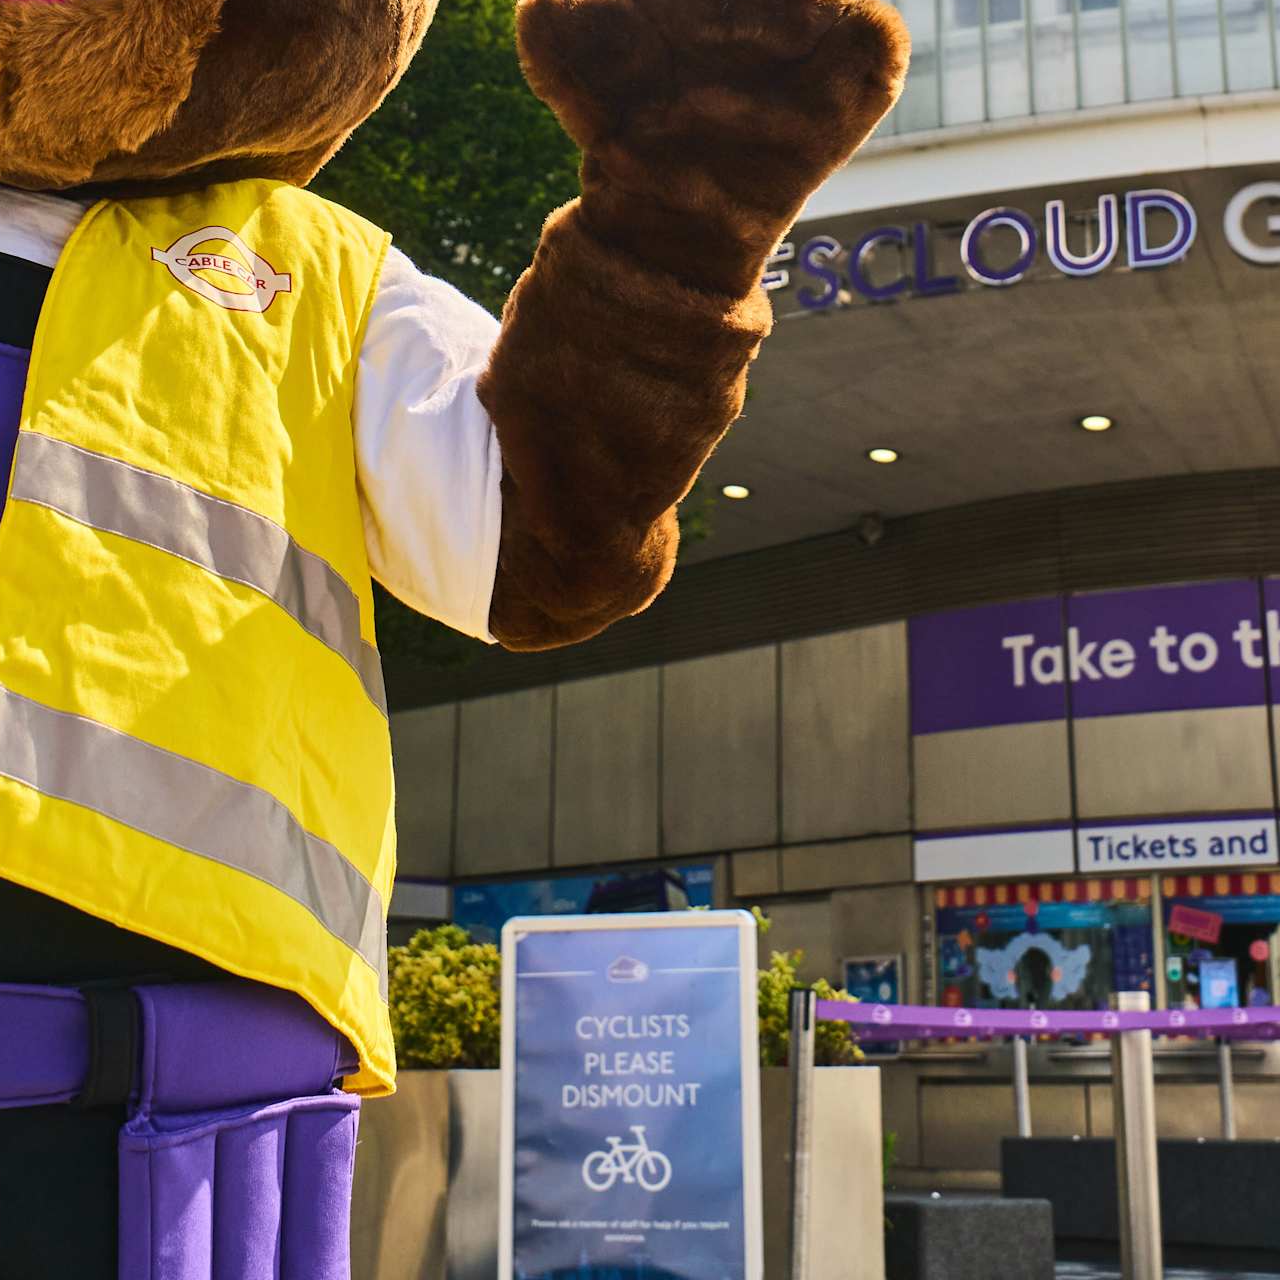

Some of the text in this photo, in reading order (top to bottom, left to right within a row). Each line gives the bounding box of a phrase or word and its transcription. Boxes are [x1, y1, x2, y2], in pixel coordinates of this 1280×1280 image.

[1002, 626, 1136, 688] Take
[1150, 625, 1218, 674] to
[1086, 832, 1197, 863] Tickets
[1209, 827, 1269, 857] and
[576, 1014, 690, 1039] CYCLISTS
[584, 1051, 675, 1075] PLEASE
[562, 1083, 701, 1108] DISMOUNT
